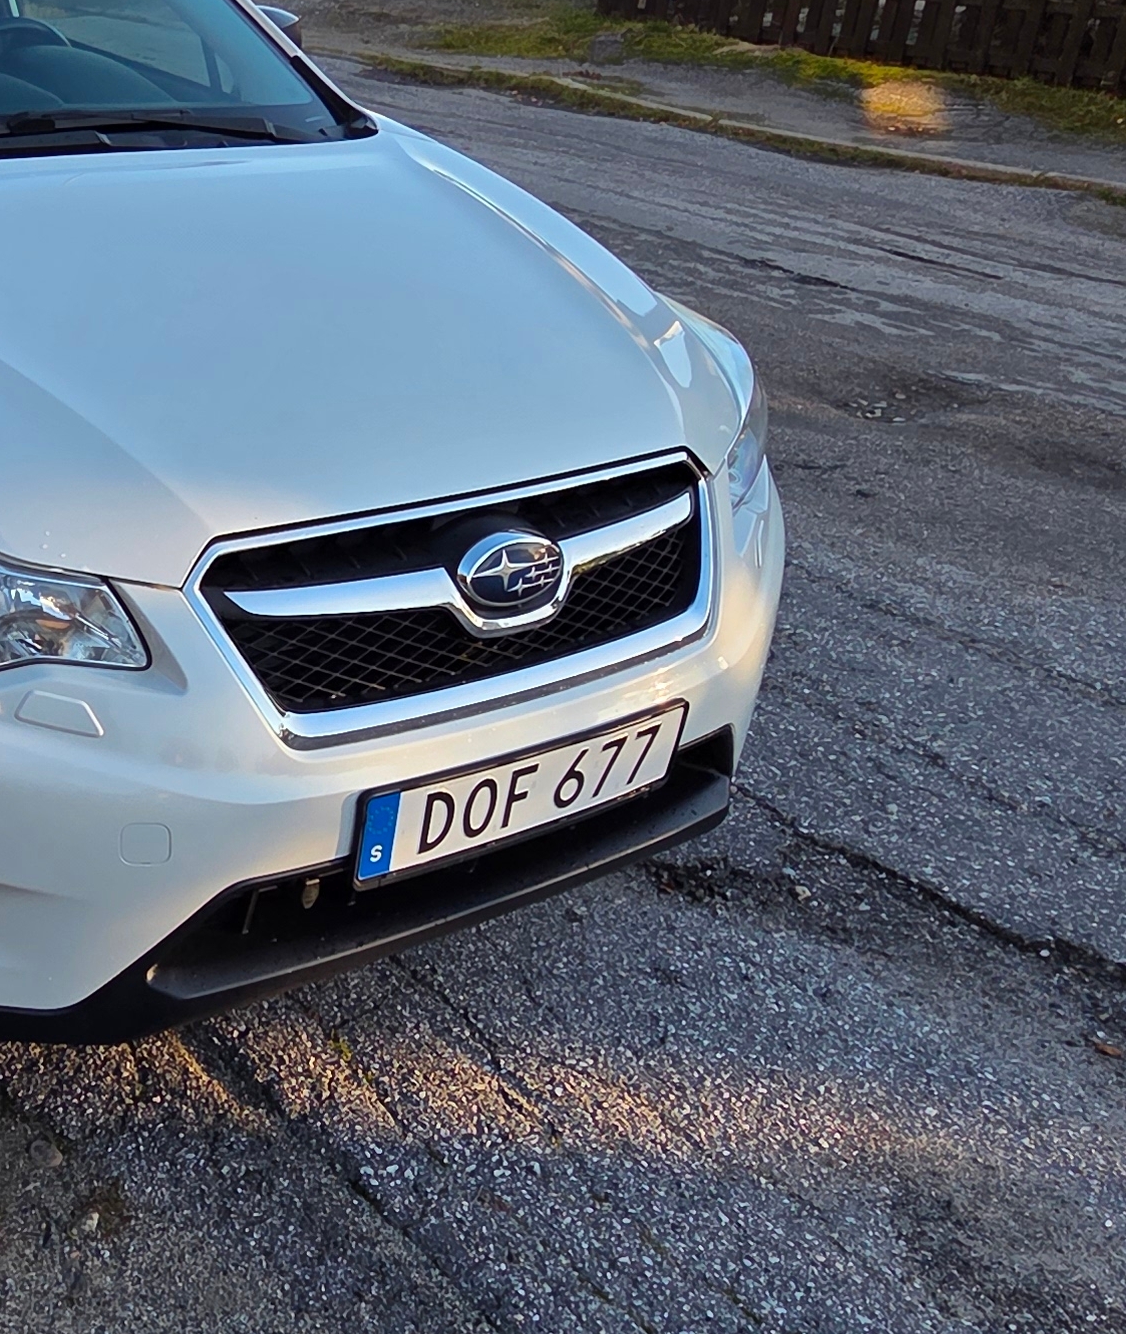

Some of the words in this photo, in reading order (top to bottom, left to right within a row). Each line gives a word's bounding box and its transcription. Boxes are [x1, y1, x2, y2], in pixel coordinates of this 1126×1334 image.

[418, 764, 539, 854] DOF
[553, 723, 661, 809] 677
[370, 844, 383, 863] S
